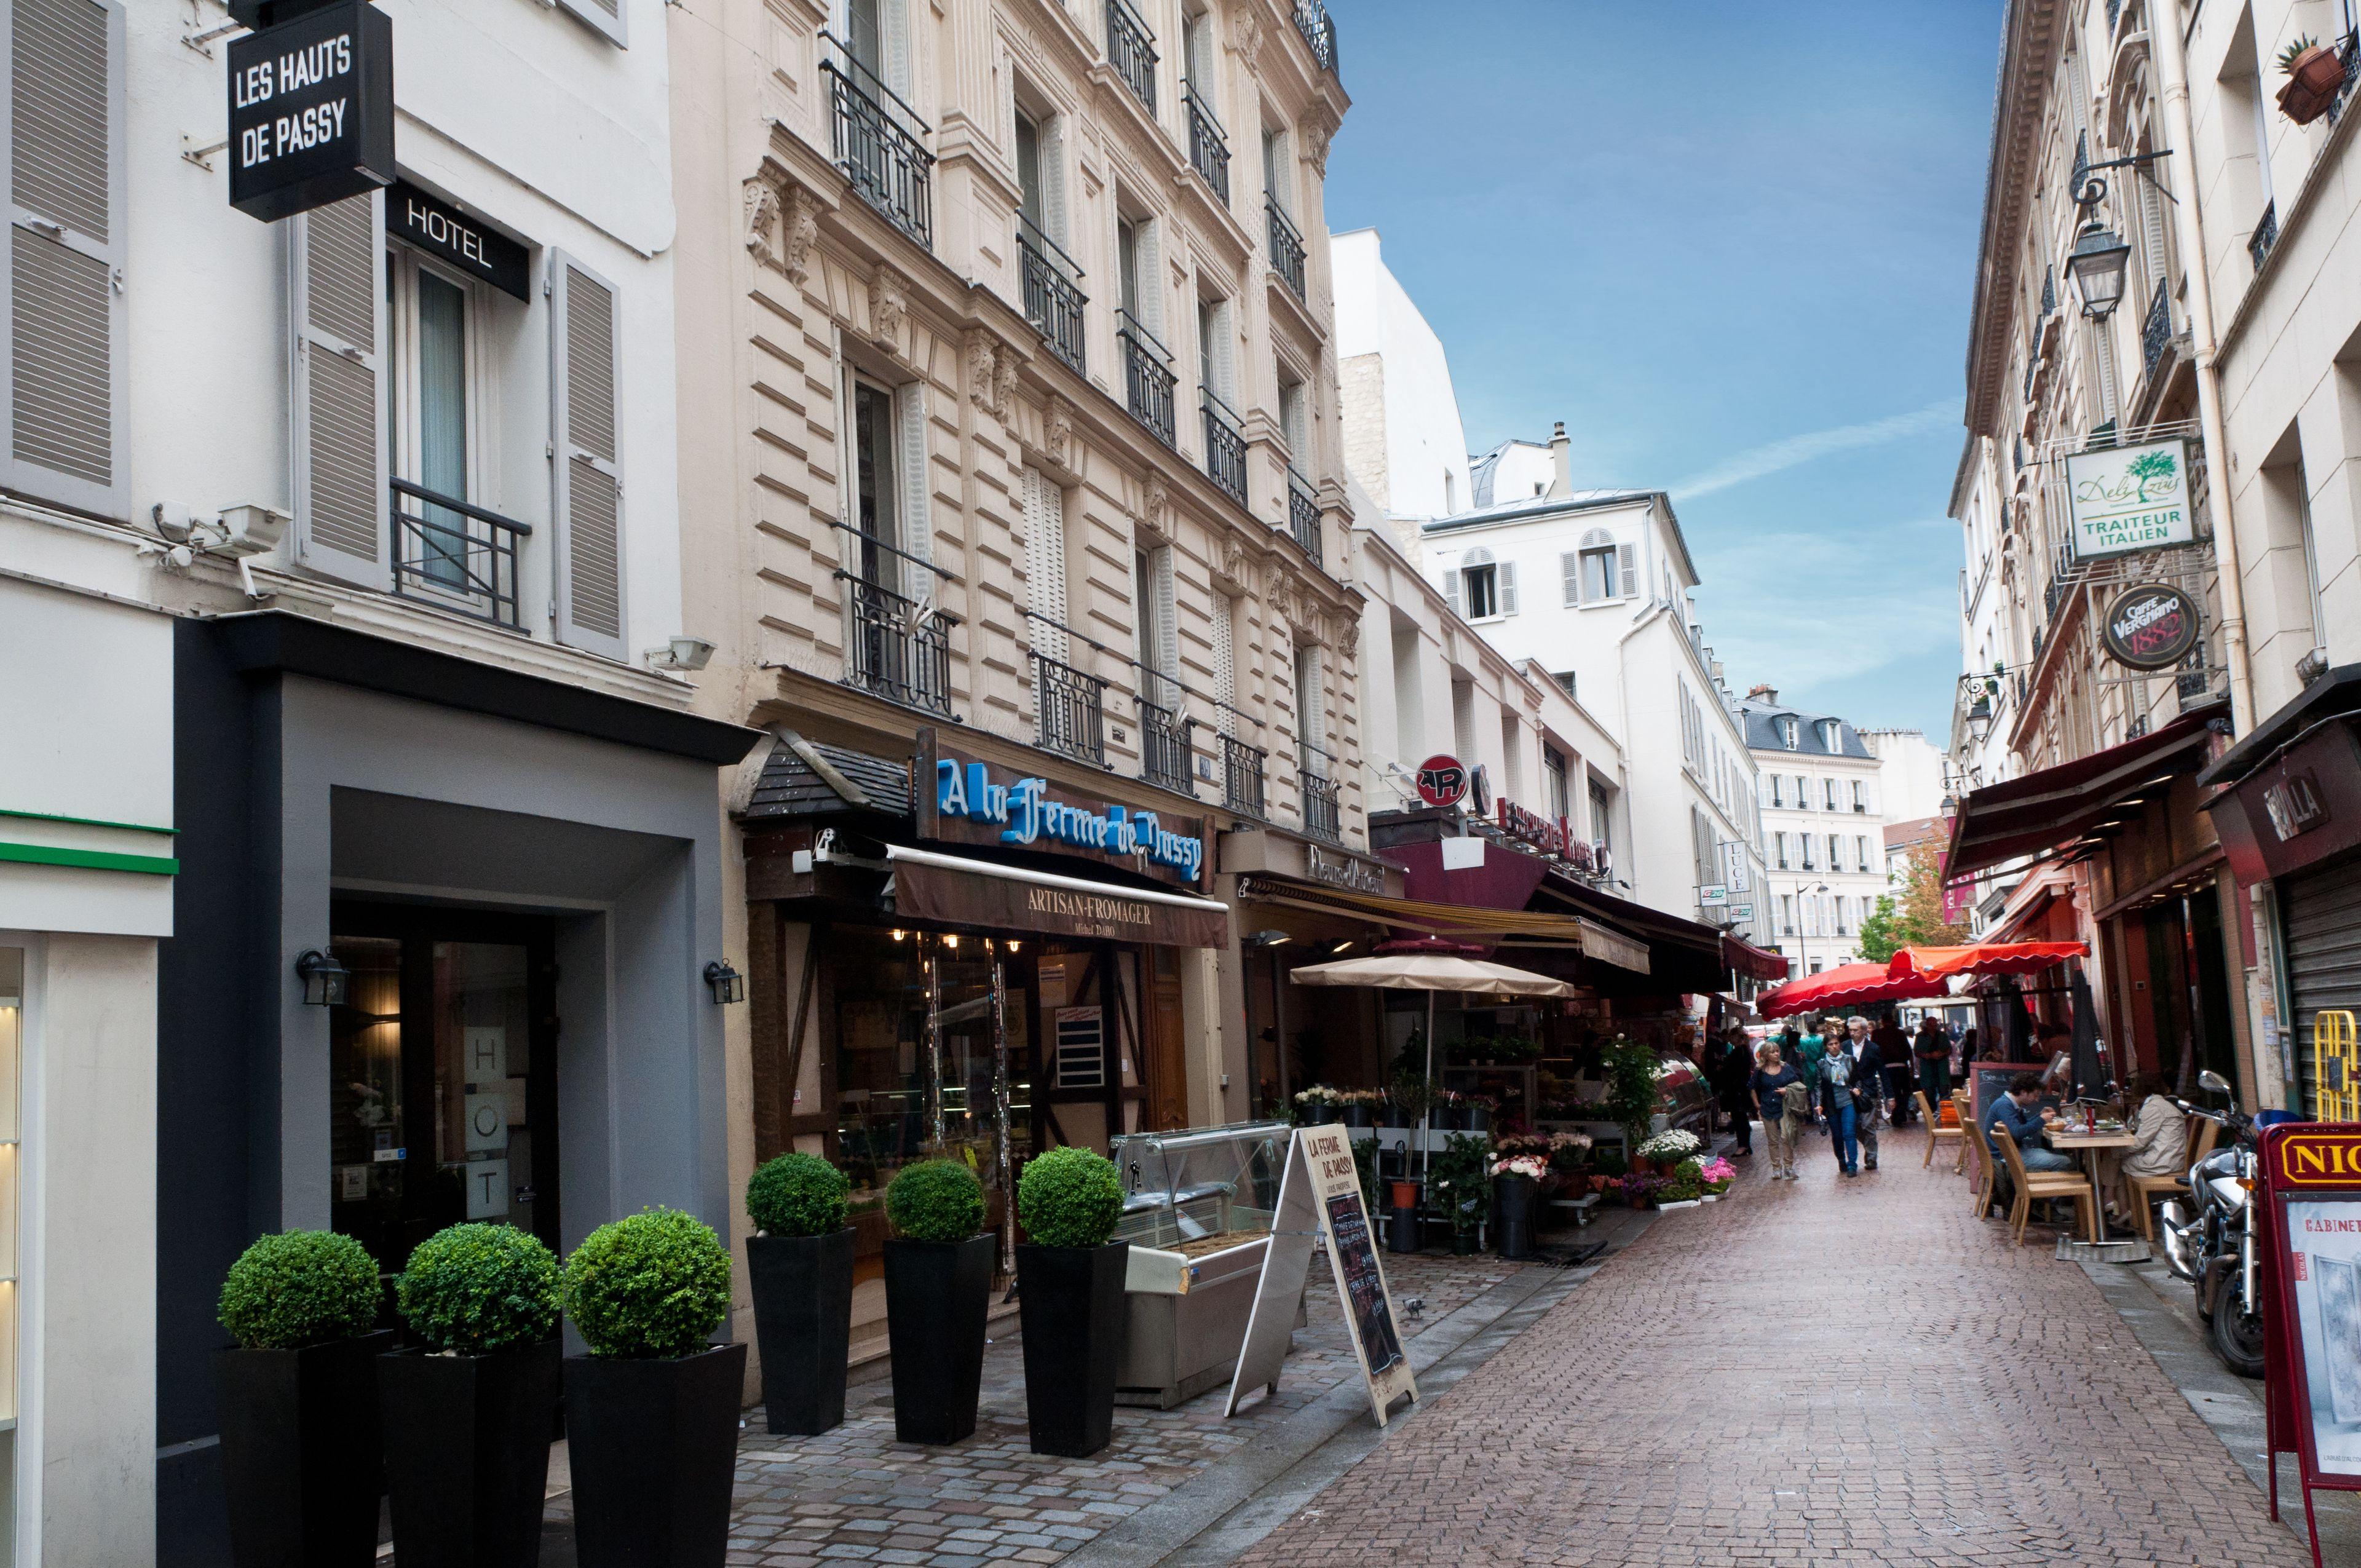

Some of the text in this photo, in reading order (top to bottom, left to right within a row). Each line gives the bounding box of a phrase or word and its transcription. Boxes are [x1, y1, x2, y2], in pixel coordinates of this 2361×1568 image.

[237, 34, 350, 108] LES HAUTS
[243, 98, 346, 167] DE PASSY
[408, 199, 492, 269] HOTEL
[2084, 511, 2181, 534] TRAITEUR
[2100, 526, 2169, 546] ITALIEN
[2113, 597, 2179, 639] VERGNANO
[2132, 613, 2181, 655] 1882
[1201, 759, 1210, 776] 39
[939, 759, 969, 815] A
[975, 763, 1009, 823] la
[1008, 777, 1108, 848] Ferme
[1112, 806, 1137, 856] de
[1731, 844, 1744, 890] LUCE
[1029, 889, 1152, 925] ARTISAN-FROMAGER
[1703, 889, 1724, 898] G20
[1308, 1136, 1341, 1158] LA FERME
[1323, 1156, 1353, 1179] DE PASSY
